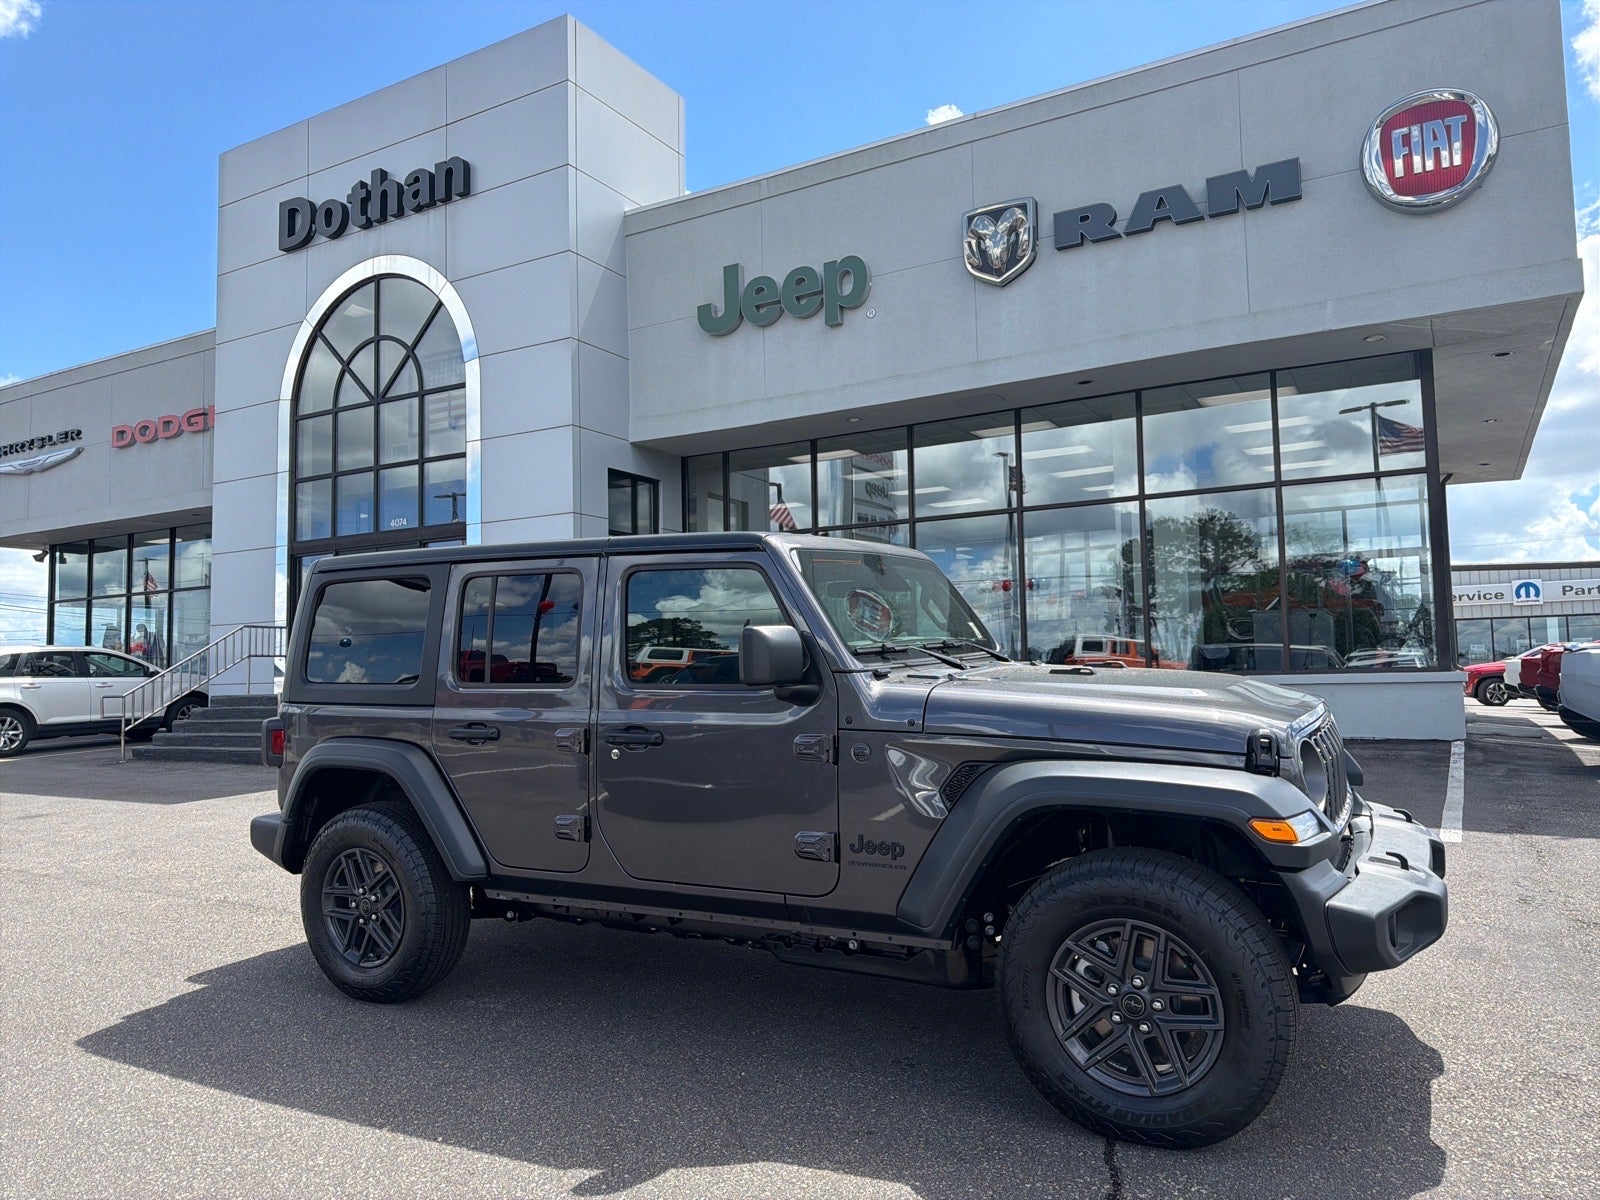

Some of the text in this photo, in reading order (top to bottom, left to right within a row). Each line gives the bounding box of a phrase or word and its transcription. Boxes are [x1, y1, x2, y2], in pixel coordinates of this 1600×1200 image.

[1391, 115, 1468, 178] FIAT
[279, 156, 471, 254] Dothan
[1053, 156, 1303, 250] RAM
[697, 254, 872, 337] Jeep
[390, 517, 407, 527] 4074
[849, 834, 905, 861] Jeep
